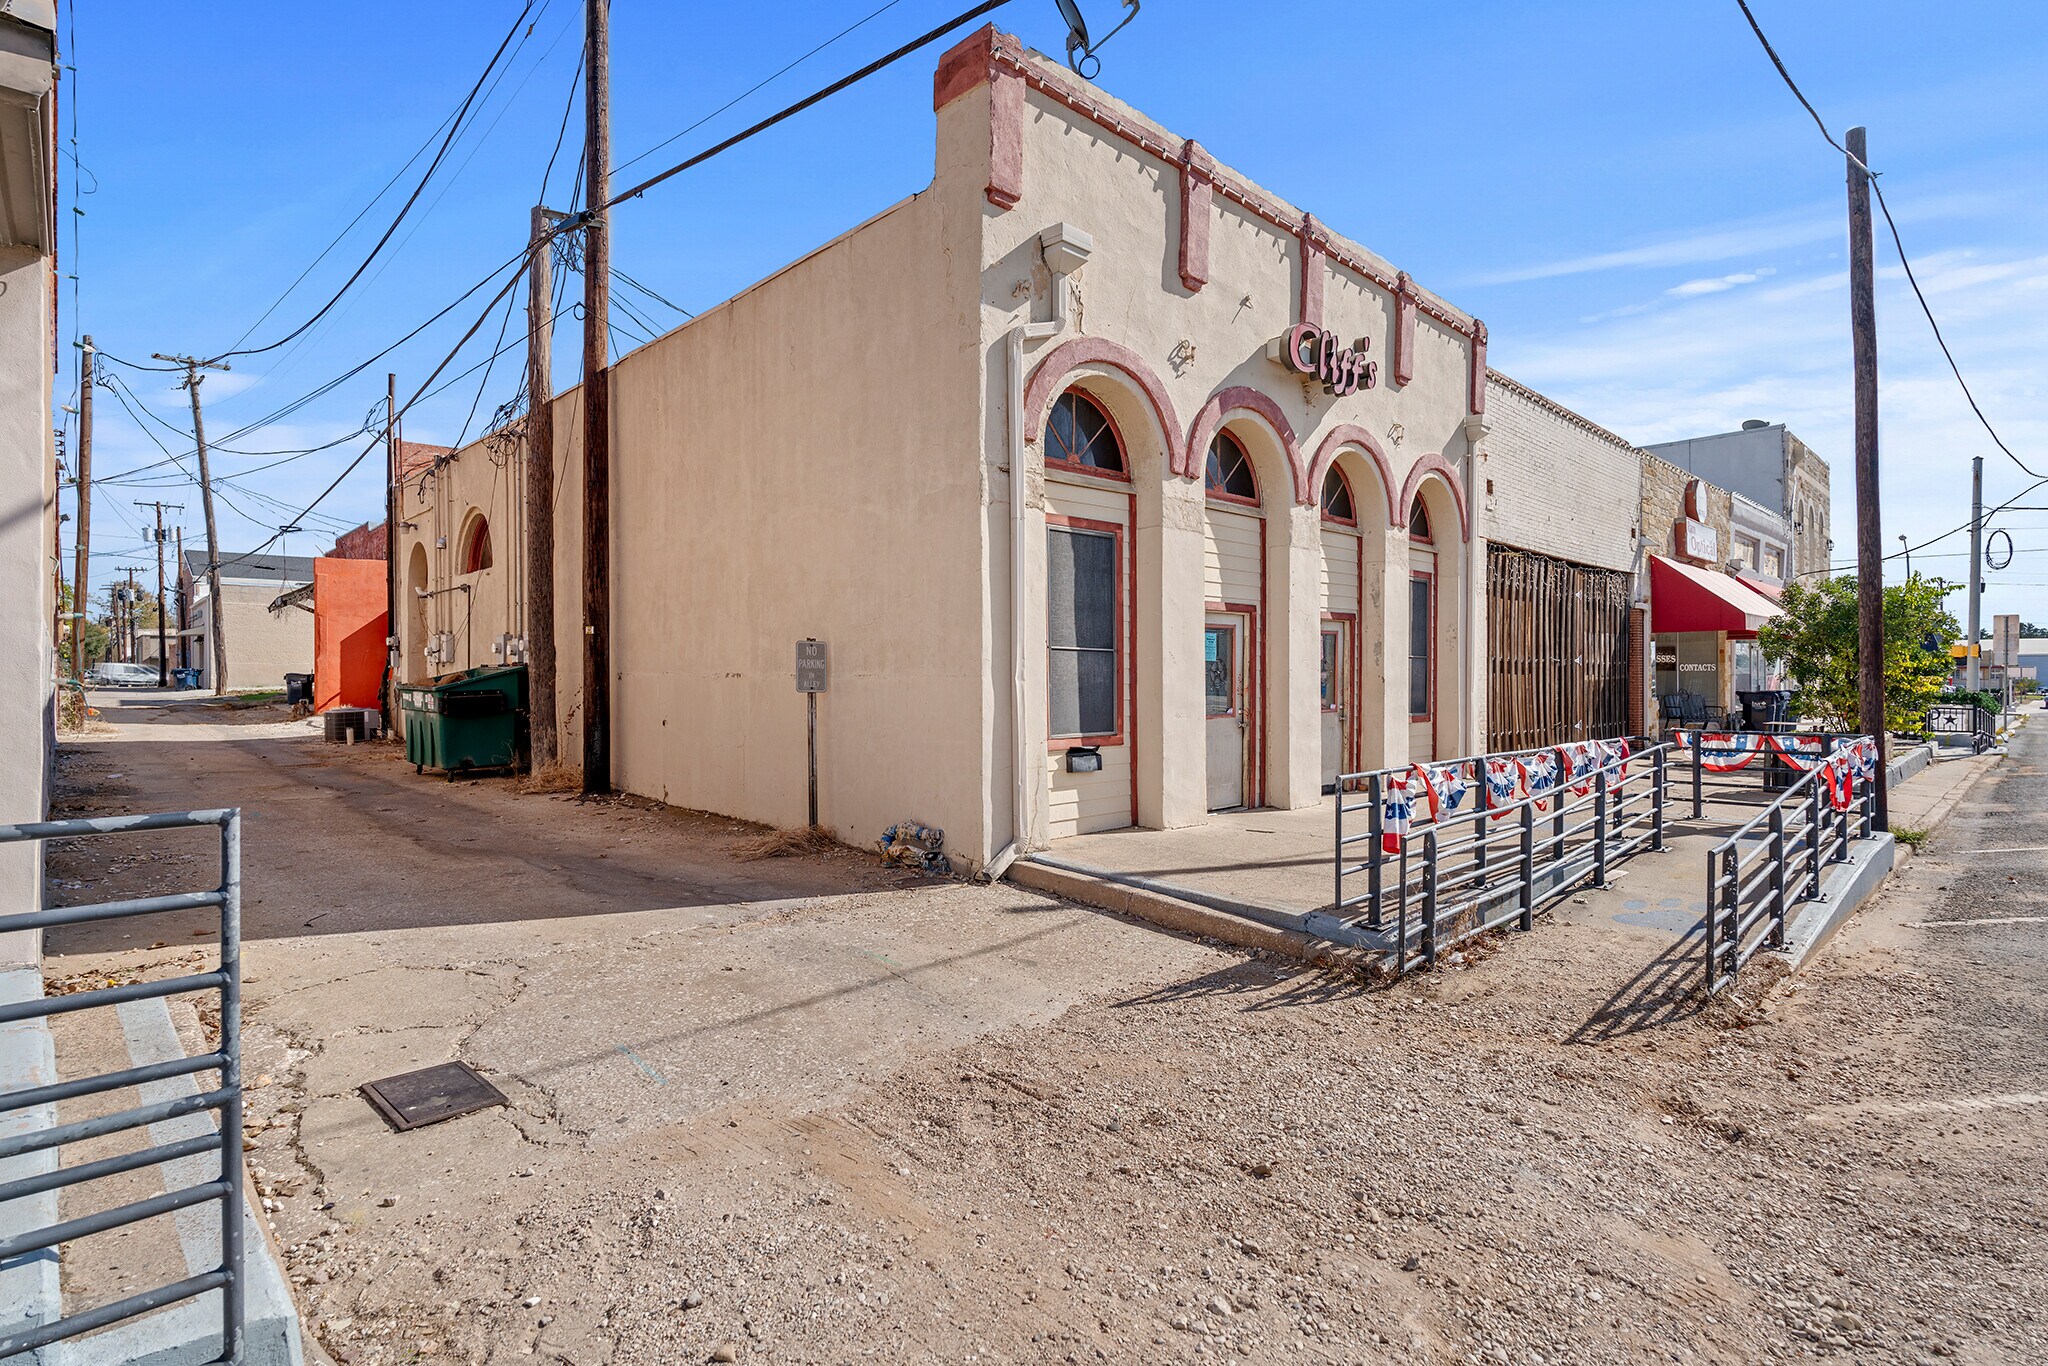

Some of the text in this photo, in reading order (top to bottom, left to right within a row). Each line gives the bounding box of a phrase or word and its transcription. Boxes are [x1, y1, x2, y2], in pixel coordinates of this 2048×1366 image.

[1285, 321, 1378, 397] Cliff's
[1690, 536, 1715, 556] Optical
[806, 646, 817, 656] NO
[798, 658, 825, 669] PARKING
[1656, 654, 1676, 663] SSES
[1679, 663, 1717, 672] CONTACTS
